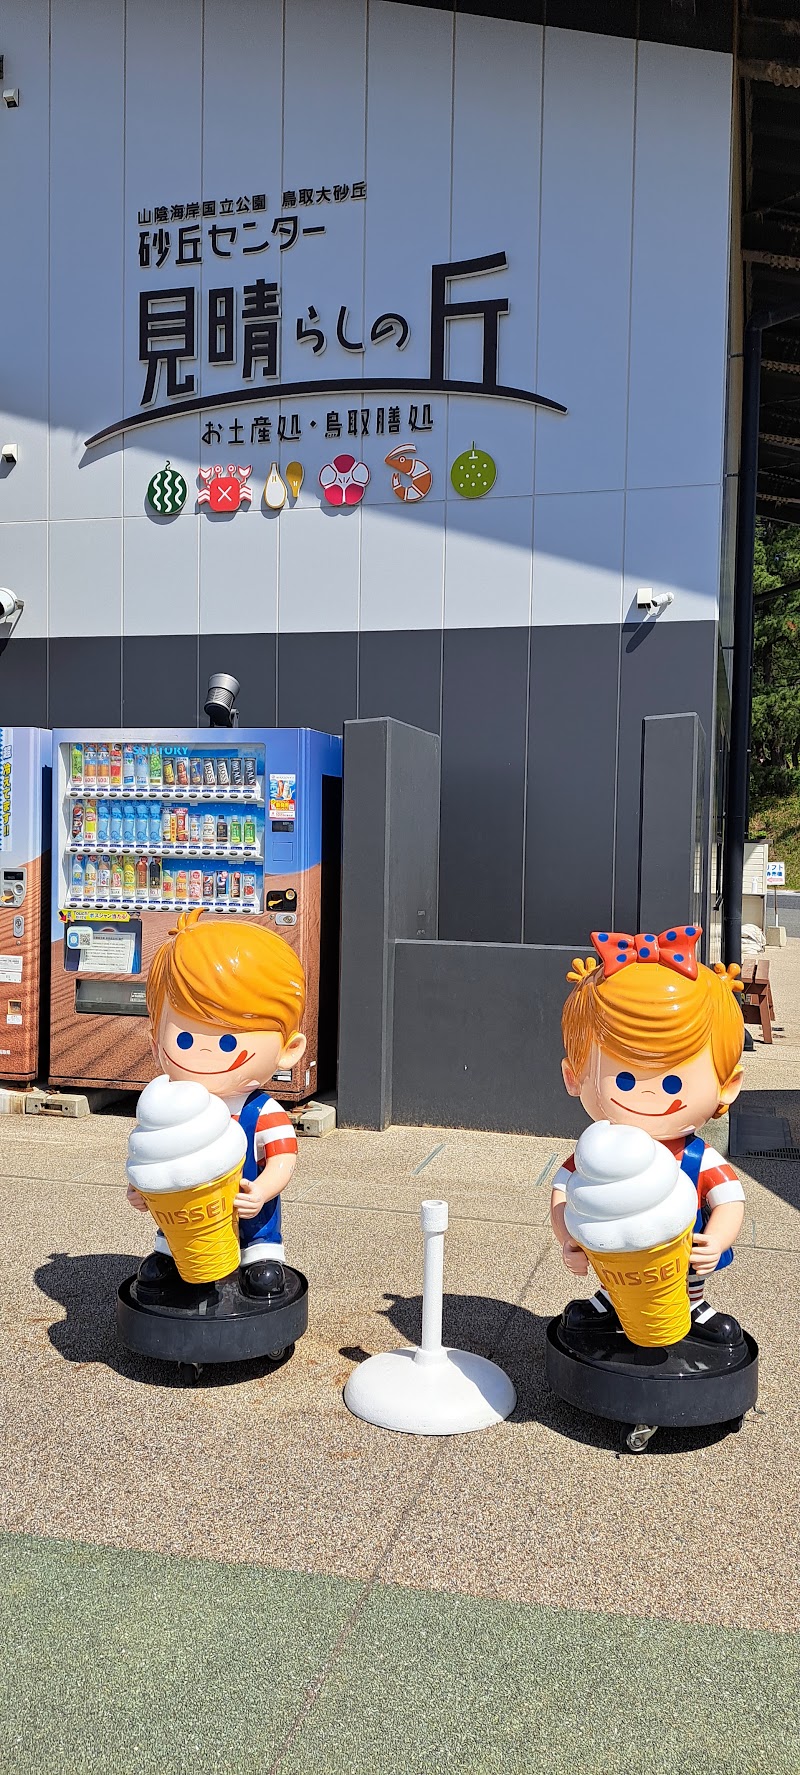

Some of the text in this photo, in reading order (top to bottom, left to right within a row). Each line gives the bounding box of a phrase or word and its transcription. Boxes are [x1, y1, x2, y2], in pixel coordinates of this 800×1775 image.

[137, 181, 368, 226] 山陰海岸国立公園 鳥取大砂丘
[137, 214, 327, 268] 砂丘センター
[138, 251, 510, 407] 見晴らしの丘
[154, 1196, 227, 1225] NISSEI
[601, 1256, 681, 1286] NISSEI
